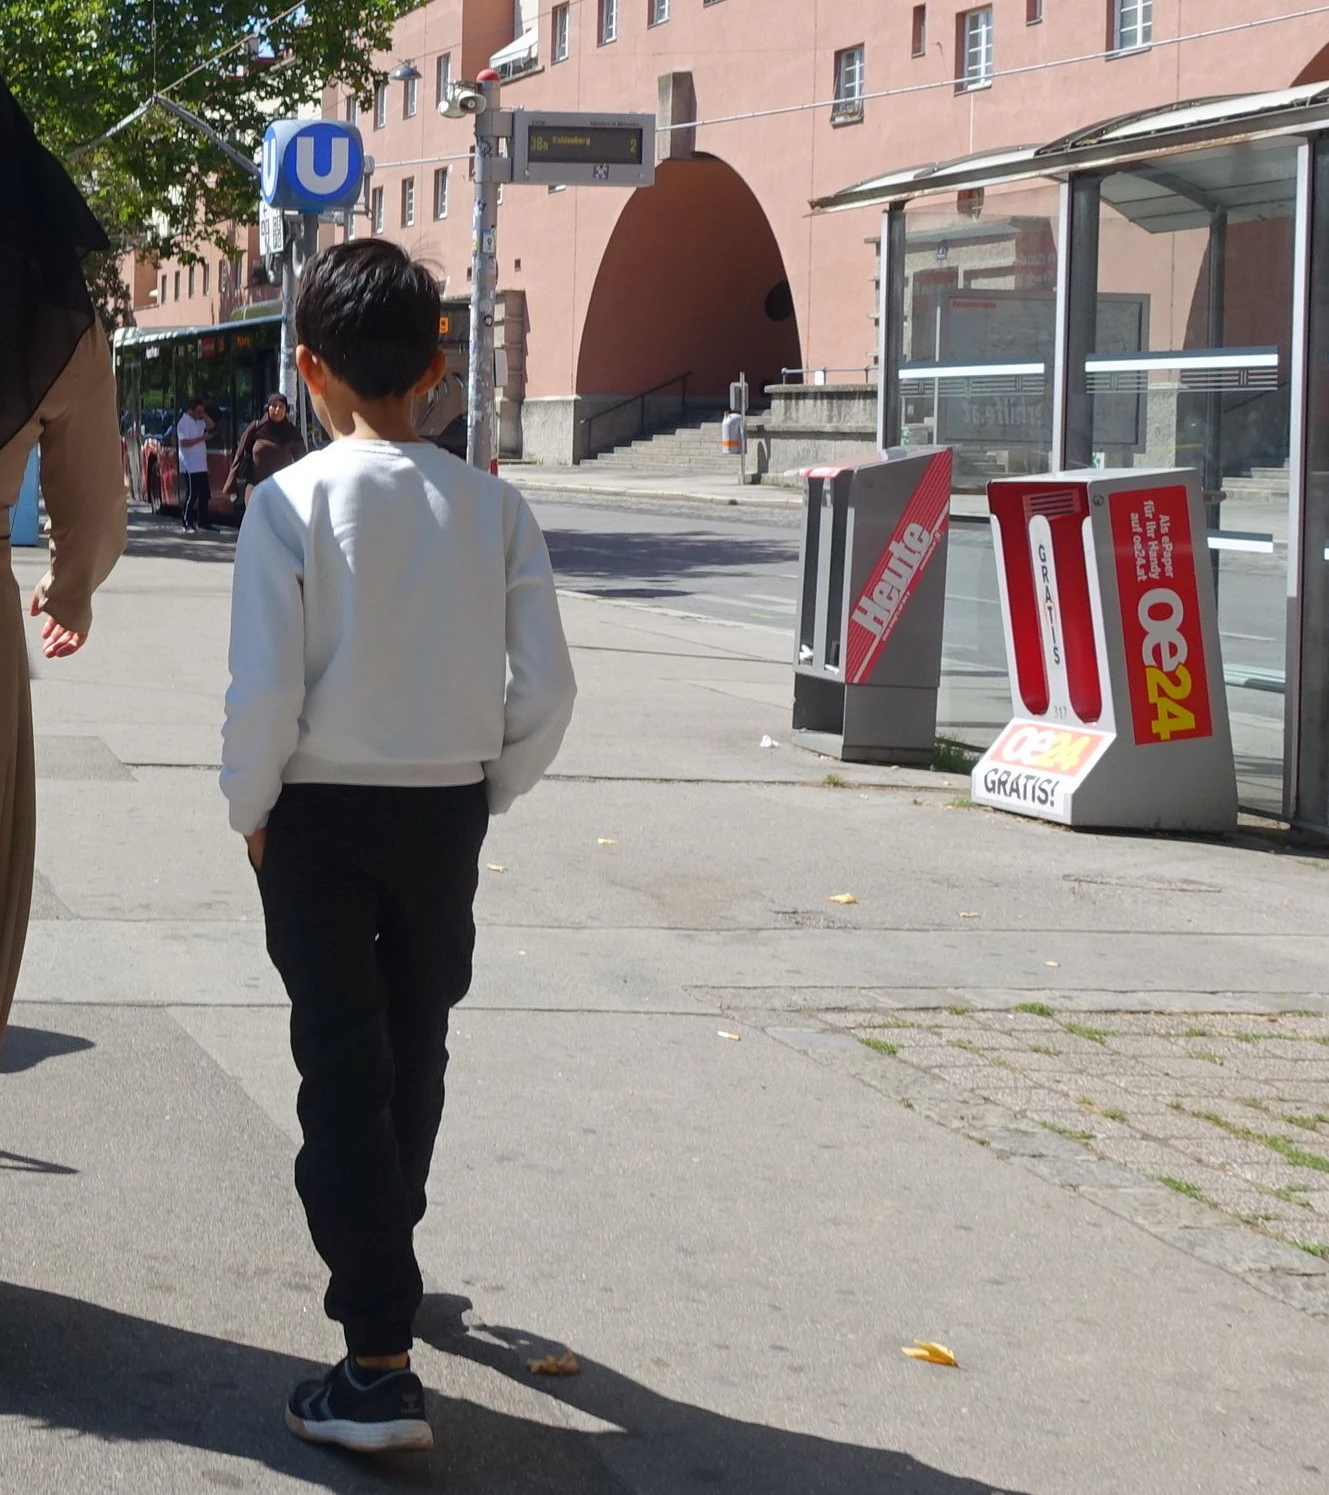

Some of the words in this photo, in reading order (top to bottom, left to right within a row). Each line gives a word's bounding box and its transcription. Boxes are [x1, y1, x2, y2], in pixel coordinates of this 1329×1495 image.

[262, 137, 276, 197] U
[296, 136, 349, 195] U
[630, 138, 637, 153] 2
[1130, 512, 1143, 533] auf
[1143, 499, 1156, 521] für
[1146, 520, 1157, 540] Ihr
[1158, 513, 1169, 535] Als
[1133, 534, 1147, 582] oe24.at
[1147, 539, 1160, 580] Handy
[1161, 535, 1174, 579] ePaper
[851, 521, 932, 638] Heute
[1038, 543, 1060, 666] GRATIS
[1137, 587, 1196, 741] oe24
[1001, 725, 1083, 771] oe24
[983, 767, 1060, 807] GRATIS!
